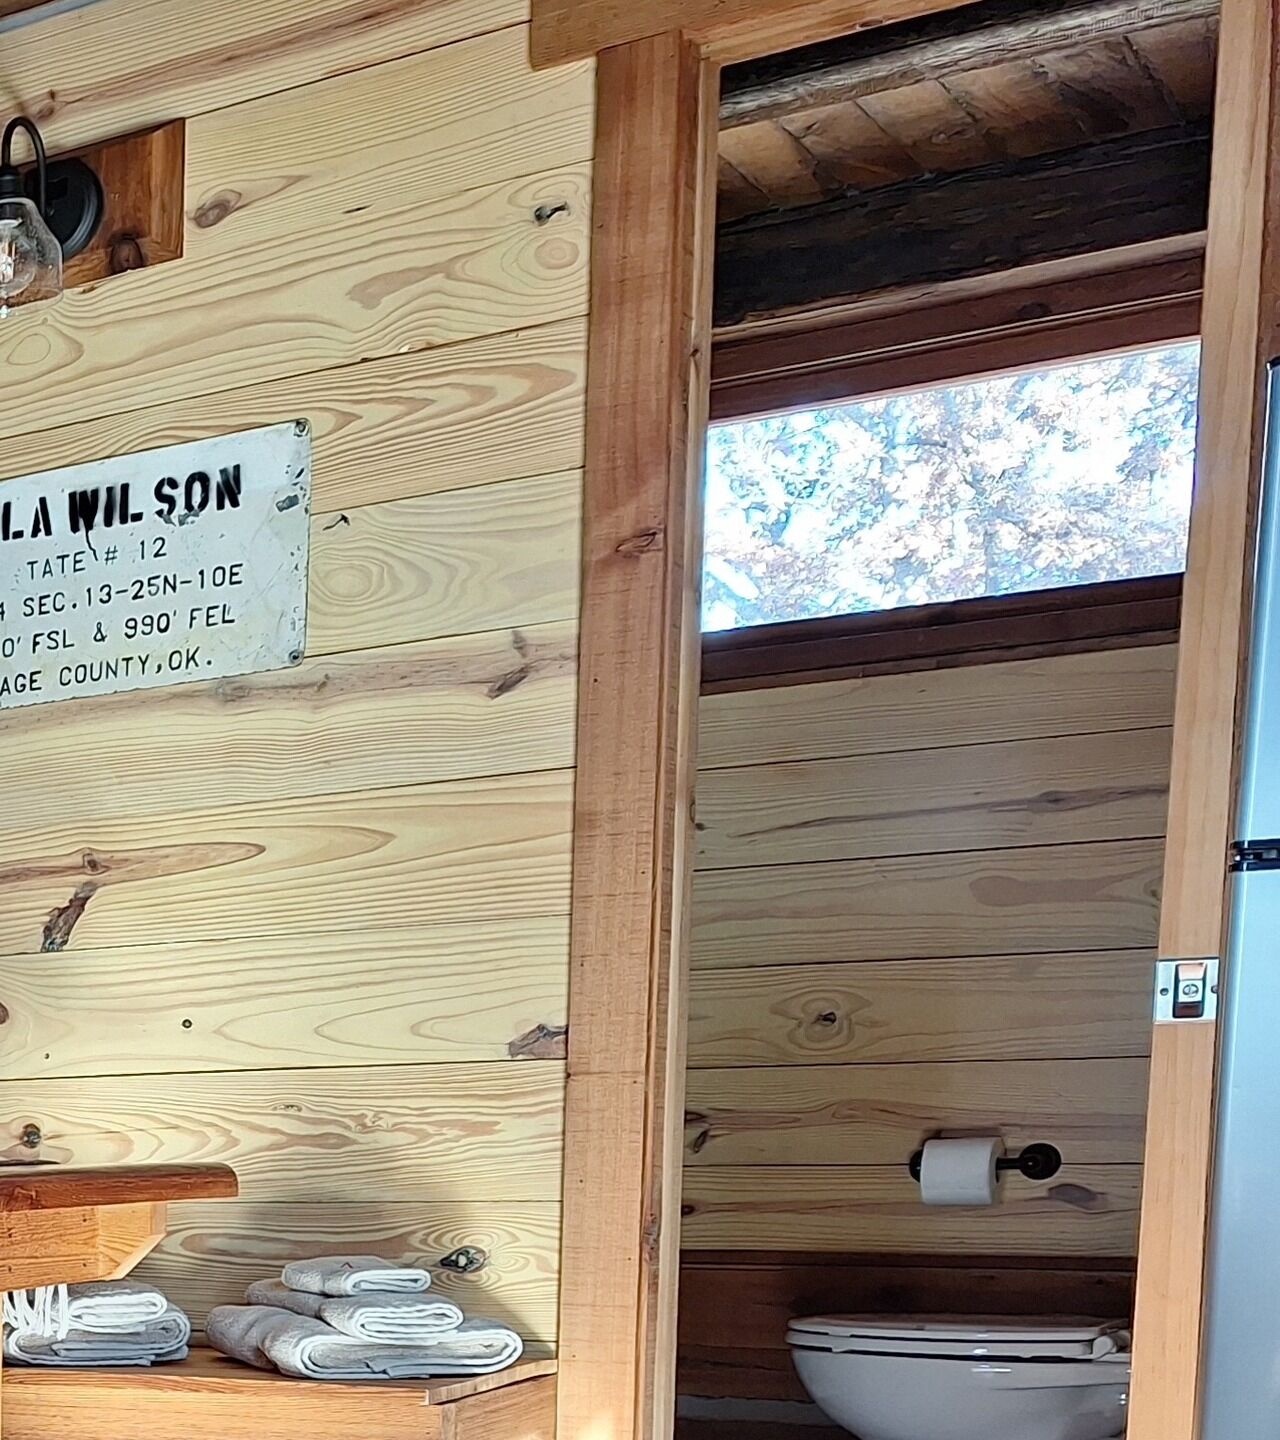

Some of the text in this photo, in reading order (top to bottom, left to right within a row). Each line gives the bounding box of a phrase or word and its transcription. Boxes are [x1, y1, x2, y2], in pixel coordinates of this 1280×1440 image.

[68, 464, 242, 533] WILSON
[27, 537, 167, 581] TATE # 12
[33, 631, 75, 654] FSL
[94, 623, 107, 642] &
[124, 612, 177, 639] 990'
[189, 604, 236, 629] FEL
